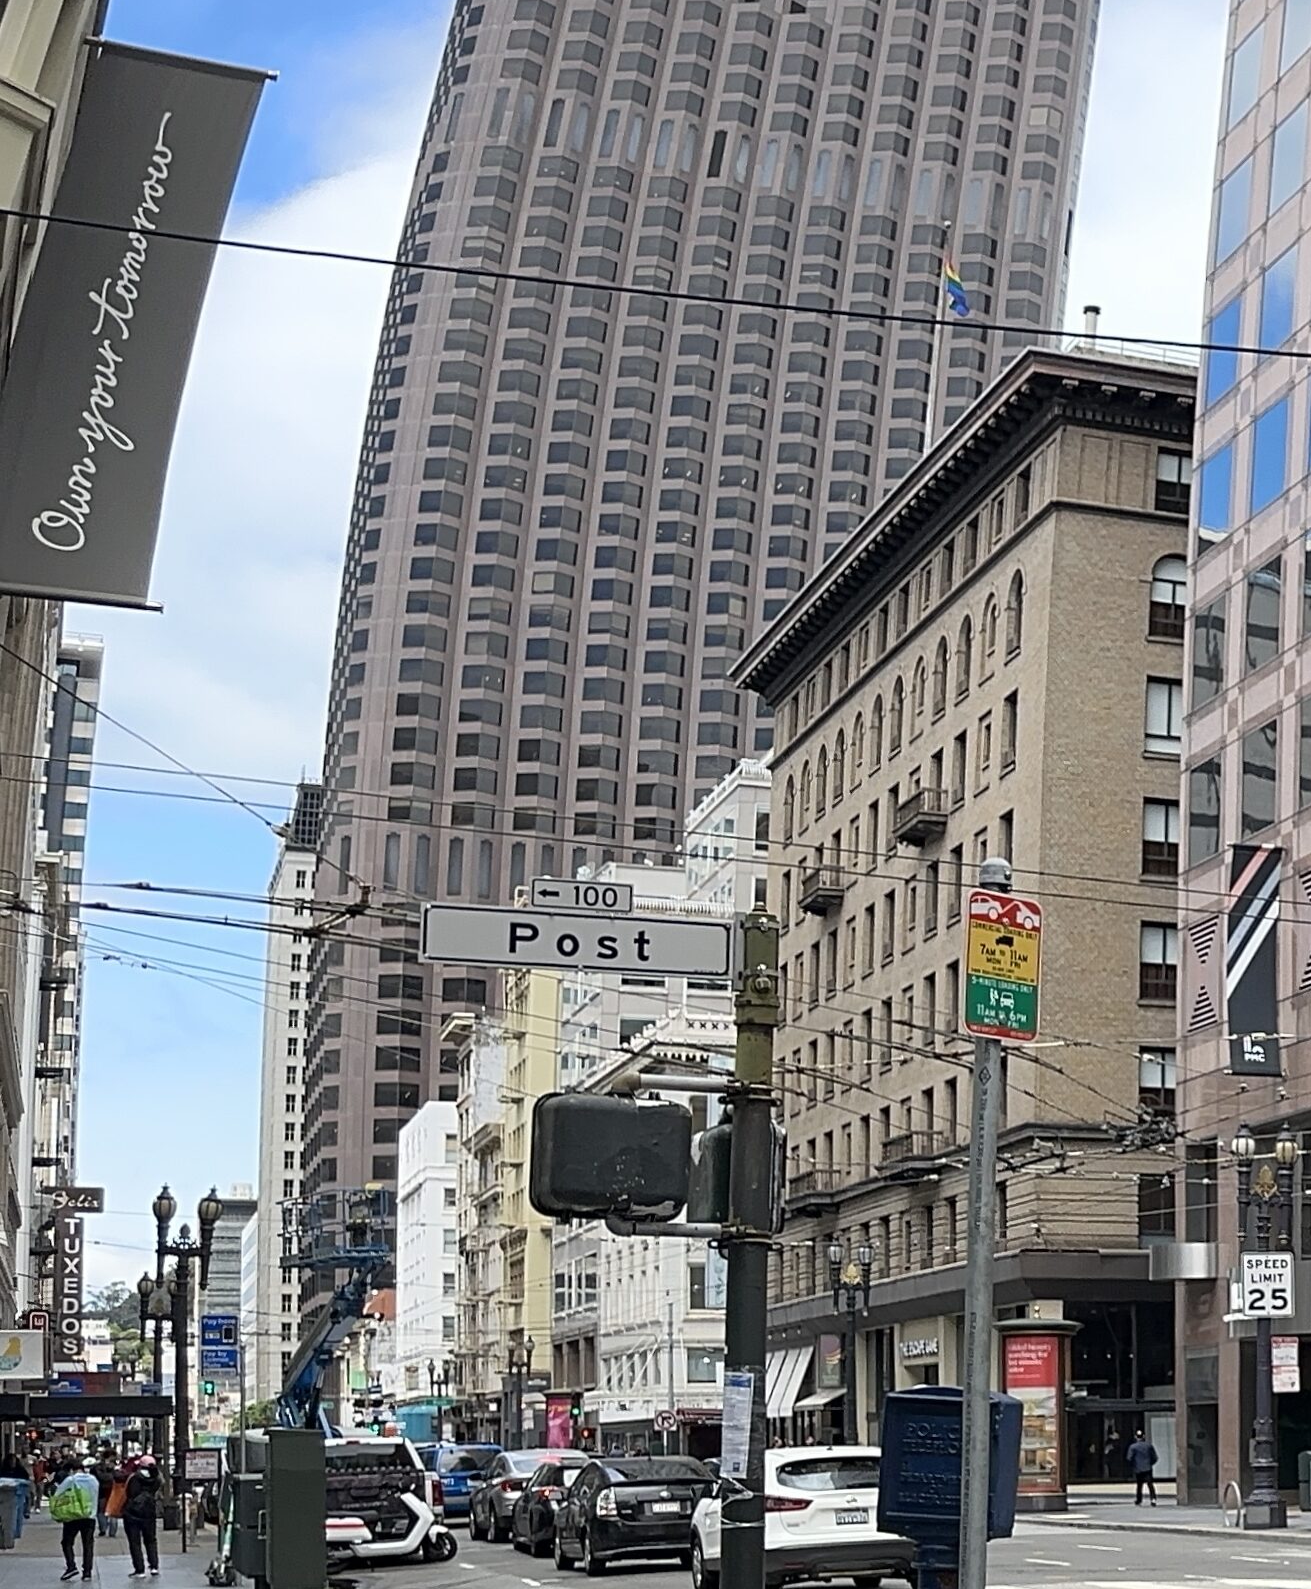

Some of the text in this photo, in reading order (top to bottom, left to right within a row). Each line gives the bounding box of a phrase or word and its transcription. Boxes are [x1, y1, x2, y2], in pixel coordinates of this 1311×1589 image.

[31, 110, 173, 552] Own your tomorrow
[572, 884, 619, 908] 100
[508, 921, 651, 962] Post
[980, 943, 996, 956] 7AM
[1010, 949, 1028, 963] 11AM
[986, 956, 1022, 969] MON FRI
[976, 1003, 996, 1018] 11AM
[1246, 1259, 1289, 1270] SPEED
[61, 1218, 81, 1355] TUXEDOS
[1250, 1273, 1284, 1284] LIMIT
[1247, 1288, 1289, 1311] 25
[904, 1422, 960, 1439] POLIC
